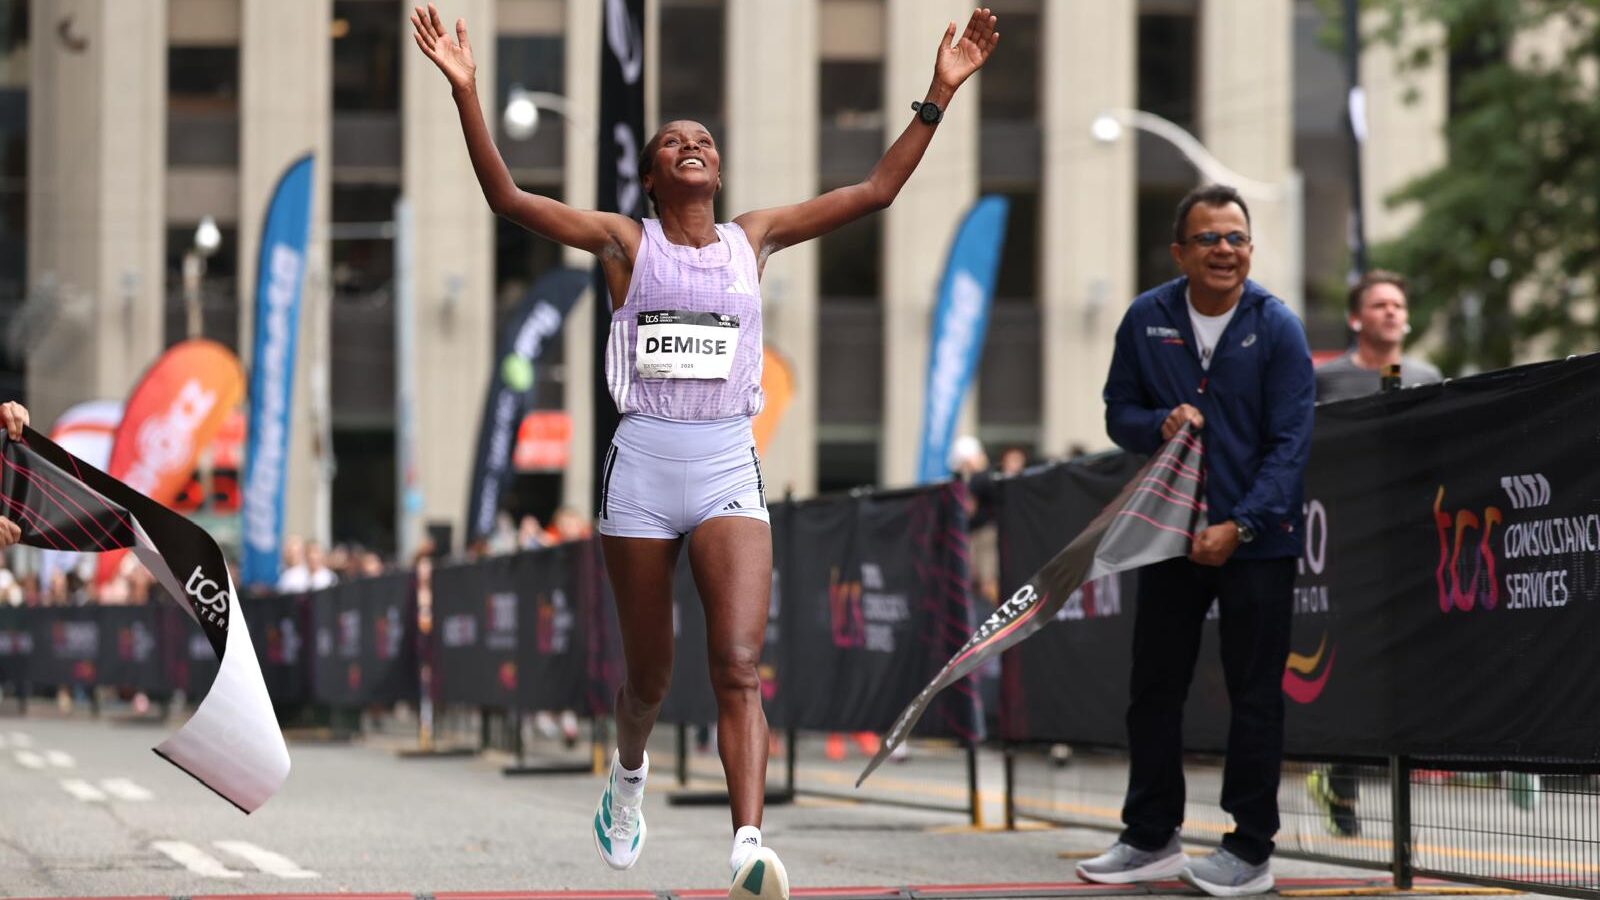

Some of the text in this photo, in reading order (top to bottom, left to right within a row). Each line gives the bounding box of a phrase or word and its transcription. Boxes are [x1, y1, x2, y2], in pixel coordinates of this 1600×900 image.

[645, 314, 659, 323] tcs
[645, 336, 727, 355] DEMISE
[1501, 473, 1551, 509] TATA
[1433, 485, 1502, 613] tcs
[185, 565, 230, 613] tcs
[1293, 585, 1329, 614] THON
[1506, 569, 1568, 609] SERVICES
